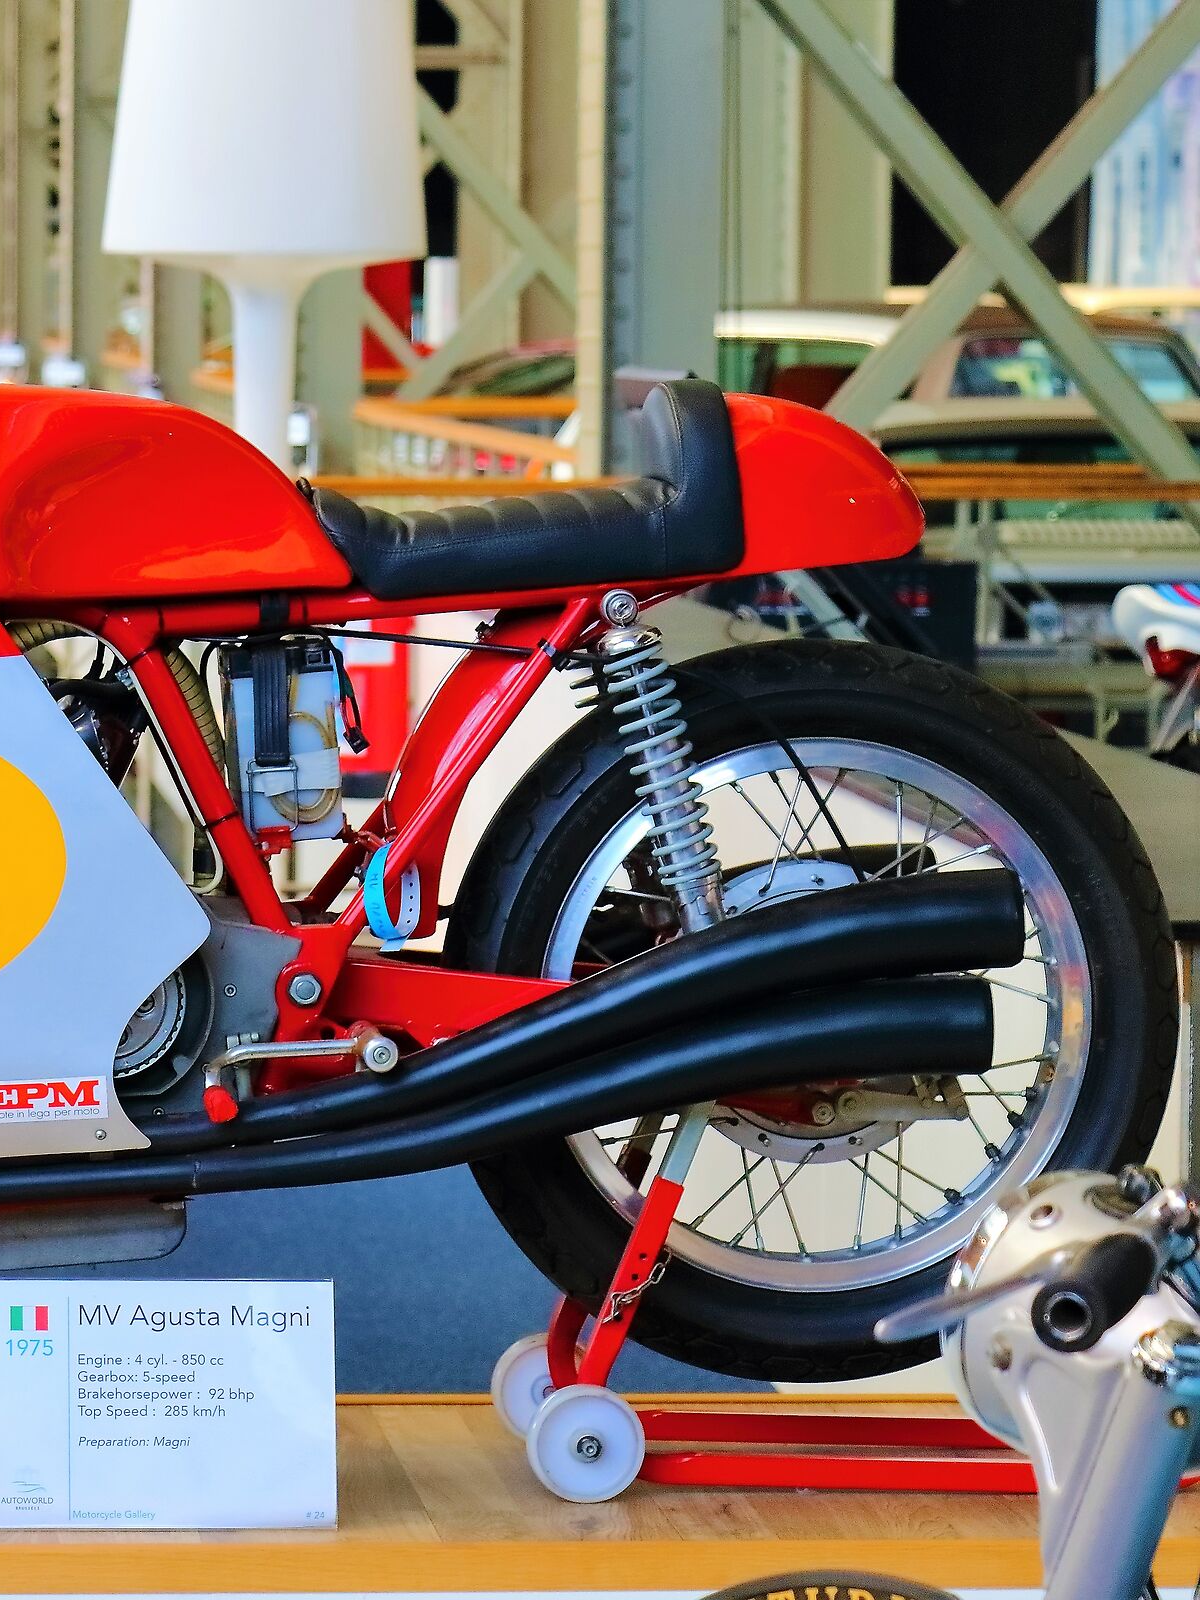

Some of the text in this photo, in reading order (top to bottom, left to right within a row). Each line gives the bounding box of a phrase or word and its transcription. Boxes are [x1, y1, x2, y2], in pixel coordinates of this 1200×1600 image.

[16, 1110, 24, 1118] in
[27, 1109, 50, 1119] lega
[54, 1110, 71, 1119] per
[73, 1108, 99, 1116] moto
[78, 1304, 311, 1333] MV Agusta Magni
[5, 1339, 54, 1356] 1975
[78, 1354, 123, 1368] Engine
[134, 1354, 143, 1366] 4
[147, 1354, 168, 1368] cyl.
[181, 1354, 206, 1366] 850
[210, 1357, 224, 1366] cc
[77, 1371, 196, 1385] Gearbox: 5-speed
[78, 1388, 192, 1402] Brakehorsepower
[208, 1388, 225, 1400] 92
[229, 1387, 255, 1402] bhp
[78, 1405, 102, 1419] Top
[106, 1405, 148, 1419] Speed
[164, 1405, 189, 1417] 285
[193, 1404, 226, 1417] km/h
[78, 1436, 191, 1450] Preparation: Magni
[1, 1497, 54, 1505] AUTOWORLD
[72, 1510, 156, 1521] Motorcycle Gallery
[314, 1511, 325, 1519] 24
